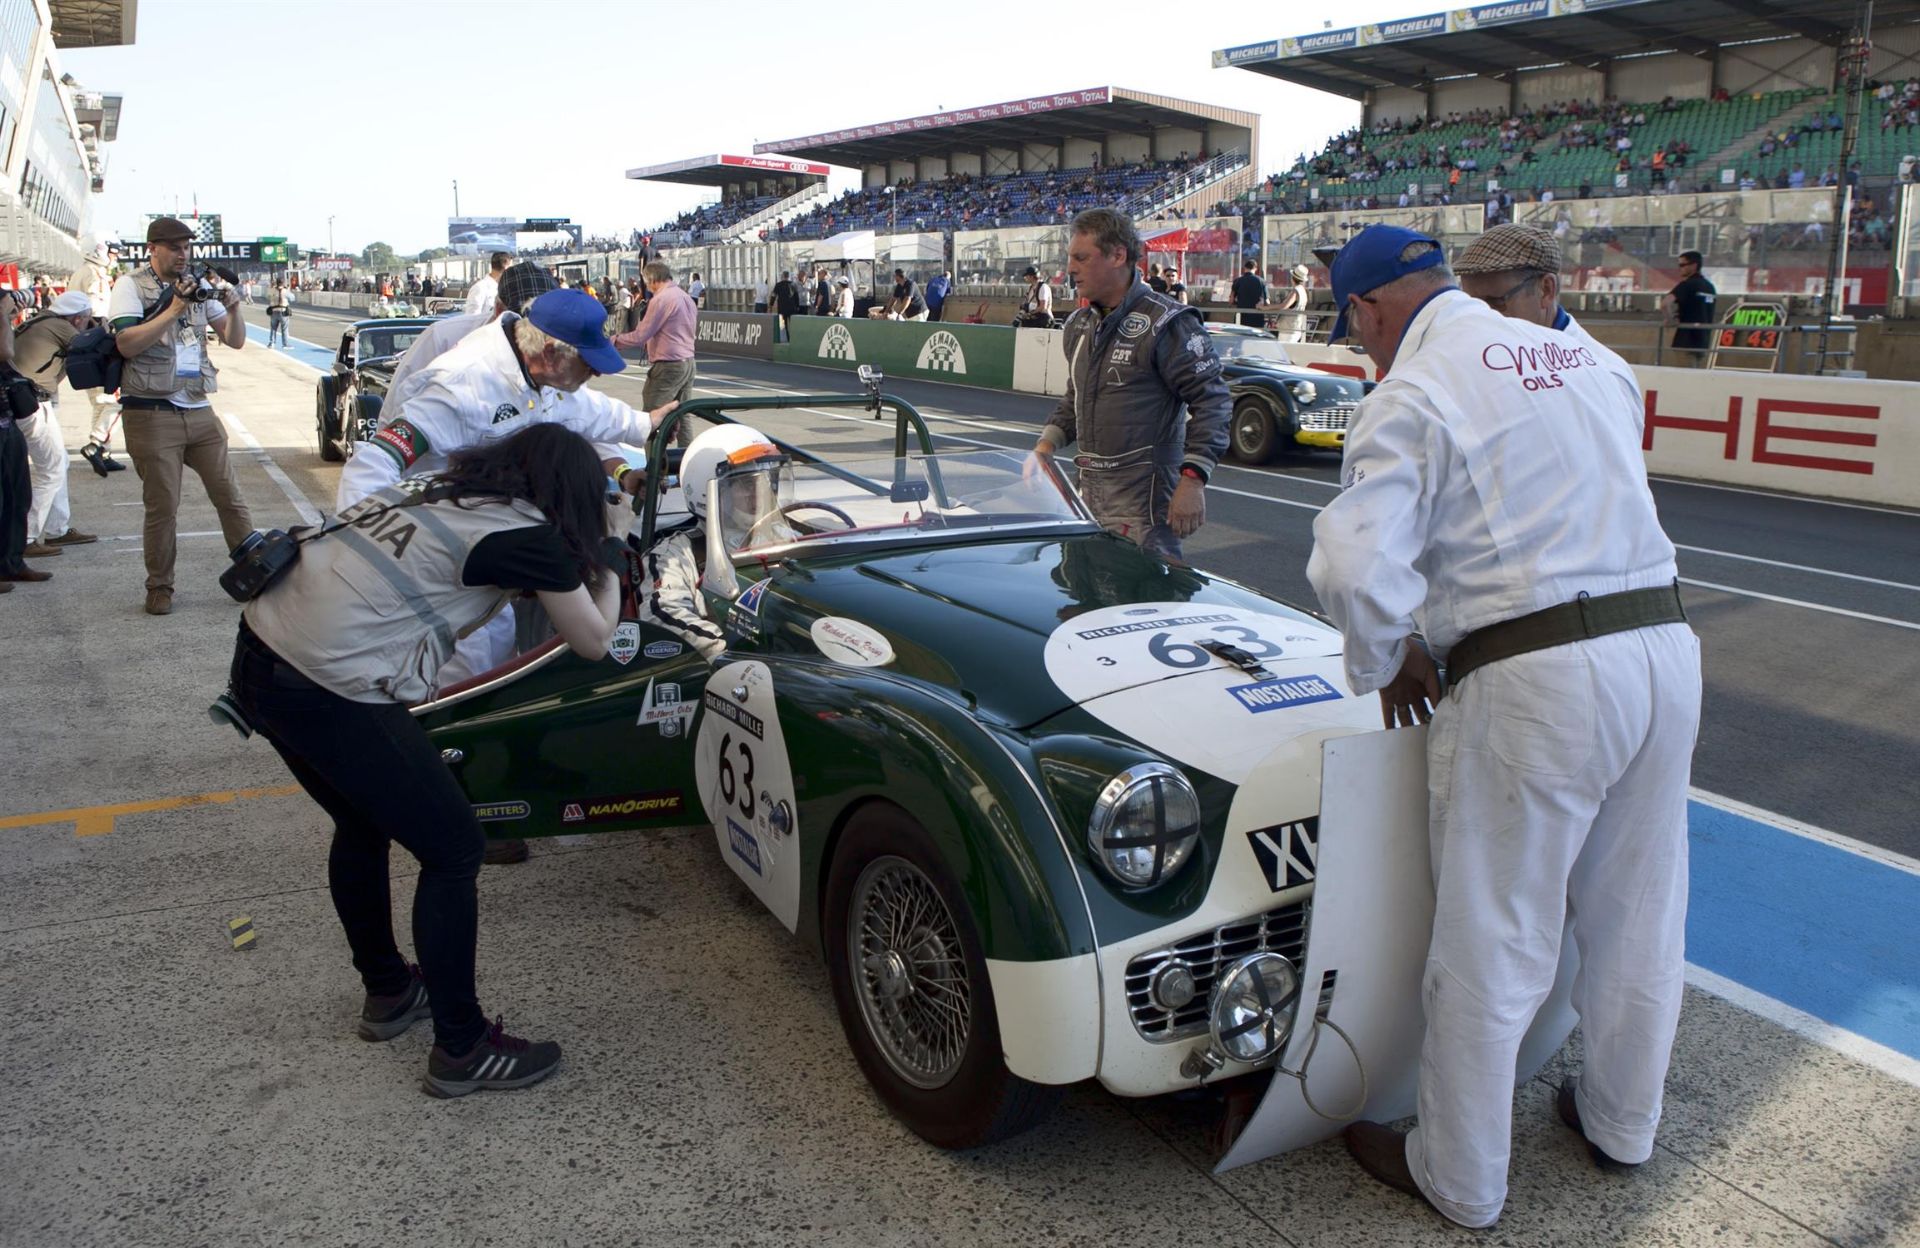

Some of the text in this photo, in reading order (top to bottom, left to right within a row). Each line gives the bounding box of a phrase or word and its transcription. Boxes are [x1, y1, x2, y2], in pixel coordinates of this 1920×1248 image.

[1478, 0, 1546, 20] MICHELIN
[1384, 17, 1444, 36] MICHELIN
[1302, 31, 1355, 48] MICHELIN
[1229, 44, 1277, 60] MICHELIN
[913, 118, 931, 128] TOTAL
[934, 115, 953, 125] TOTAL
[955, 112, 975, 121] TOTAL
[978, 108, 999, 118] TOTAL
[1002, 104, 1025, 114] TOTAL
[1027, 100, 1050, 110] TOTAL
[1053, 95, 1077, 106] TOTAL
[1081, 91, 1106, 101] TOTAL
[751, 158, 785, 169] Audi Sport
[192, 245, 251, 259] MILLE
[317, 260, 352, 270] MOTUL
[1734, 310, 1777, 327] MITCH
[744, 324, 762, 346] APP
[1747, 330, 1777, 348] 43
[1111, 349, 1132, 361] CBT
[1482, 342, 1597, 376] Millers
[1522, 374, 1564, 391] OILS
[338, 497, 418, 560] EDIA
[630, 553, 641, 584] Cano
[1081, 614, 1231, 640] RICHARD MILLE
[1148, 625, 1284, 669] 63
[1096, 656, 1117, 667] 3
[1237, 678, 1333, 708] NOSTALGIE
[645, 705, 692, 720] Millers Oils
[706, 692, 763, 737] RICHARD MILLE
[719, 732, 755, 820] 63
[588, 796, 680, 816] NANODRIVE
